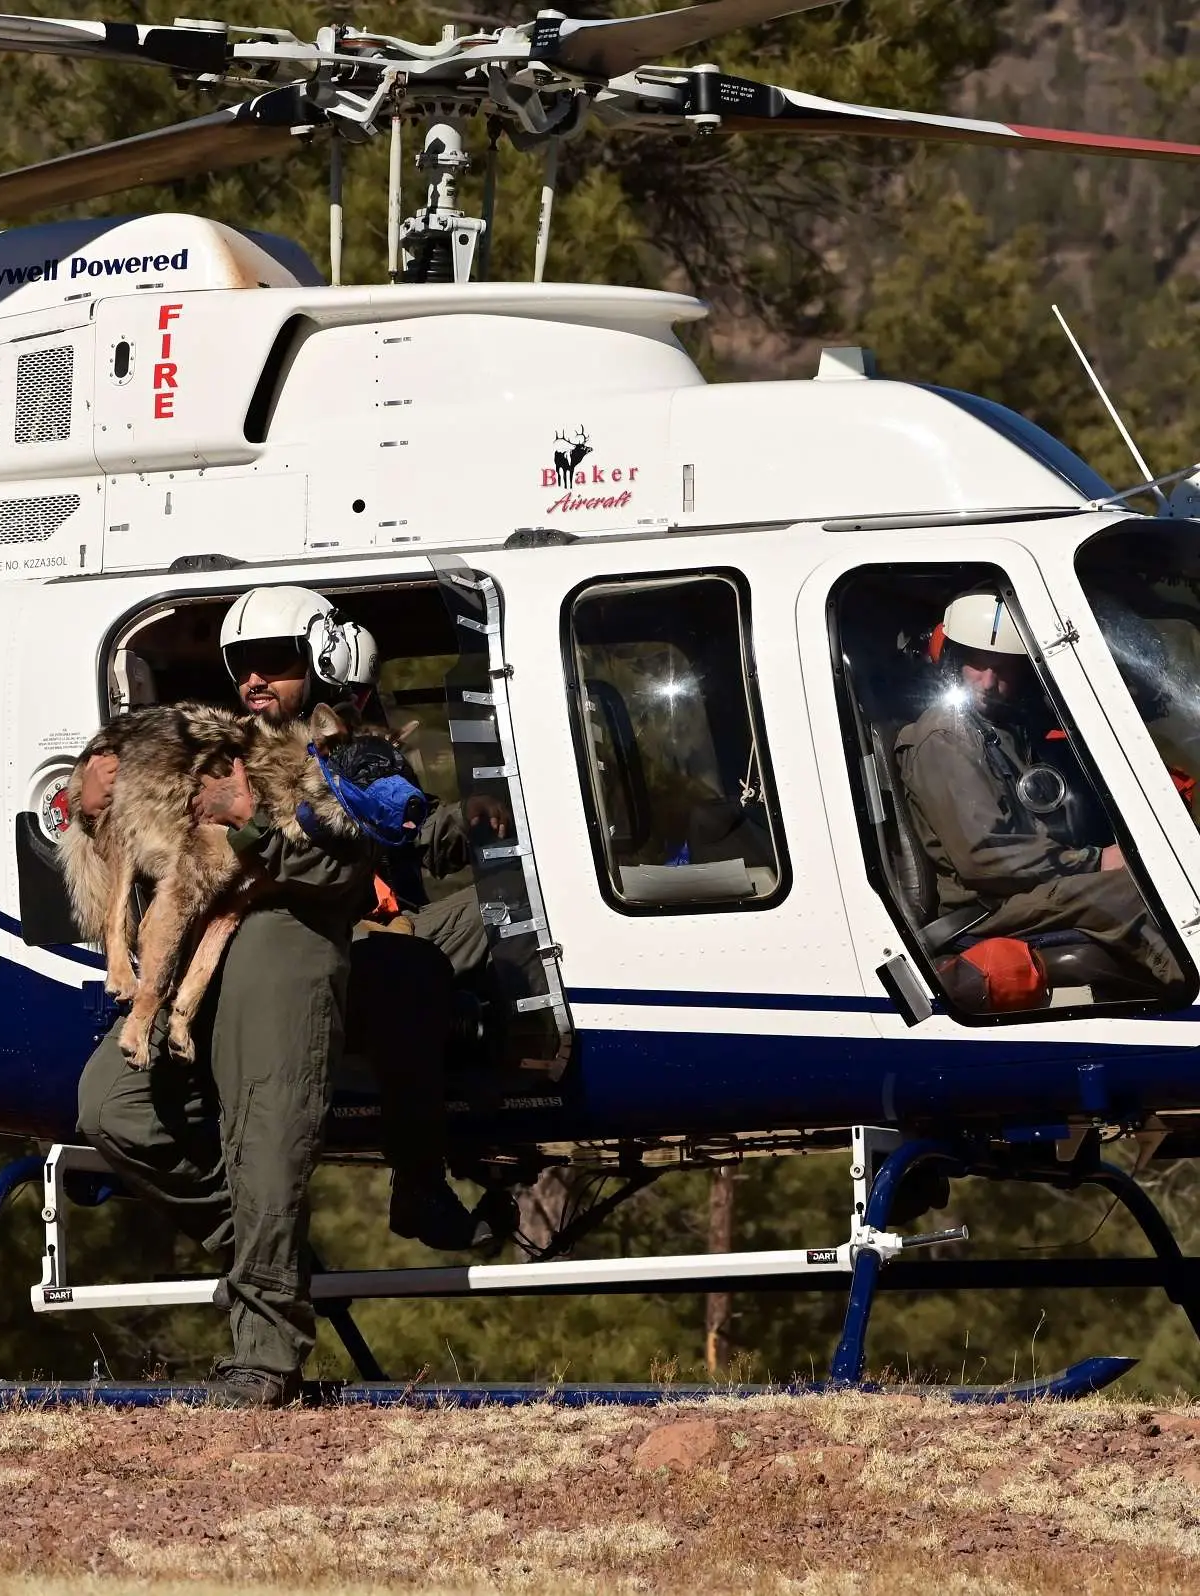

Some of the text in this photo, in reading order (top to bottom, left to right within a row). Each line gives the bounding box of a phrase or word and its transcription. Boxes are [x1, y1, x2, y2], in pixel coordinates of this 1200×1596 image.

[70, 248, 189, 279] Powered
[153, 304, 183, 419] FIRE
[541, 464, 639, 487] Baker
[546, 490, 632, 514] Aircraft
[812, 1252, 836, 1261] DART
[49, 1291, 71, 1300] DART
